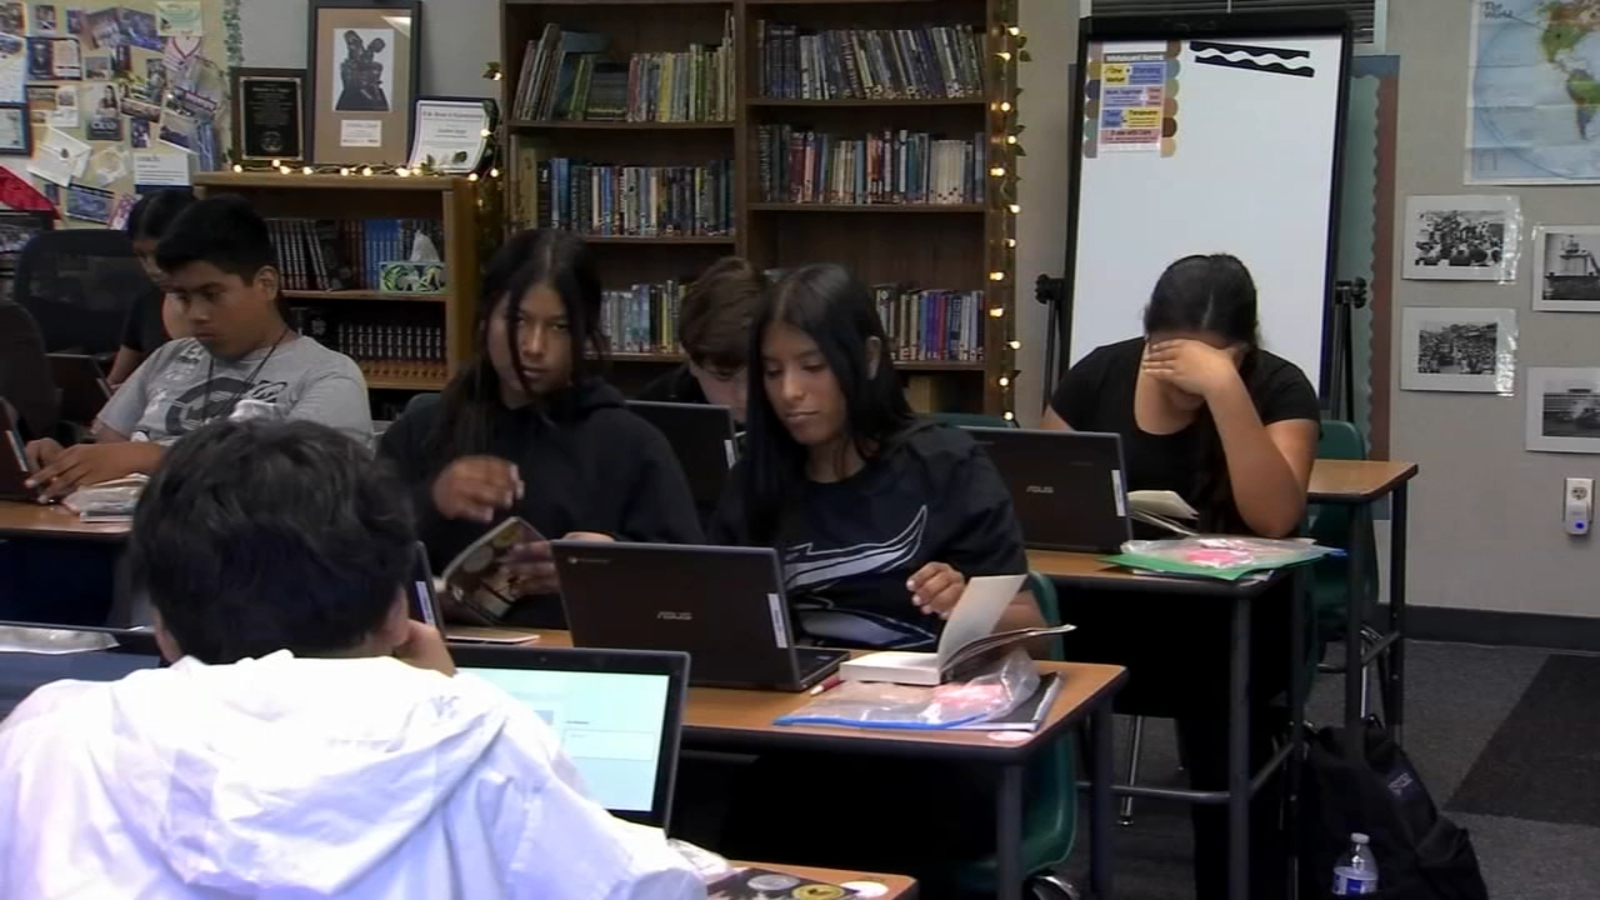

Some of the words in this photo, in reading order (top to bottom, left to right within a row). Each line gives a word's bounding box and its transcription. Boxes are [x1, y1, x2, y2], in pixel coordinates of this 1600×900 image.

[1484, 1, 1503, 11] The
[1483, 10, 1514, 19] World
[1025, 485, 1054, 494] ASUS
[656, 611, 692, 621] ASUS
